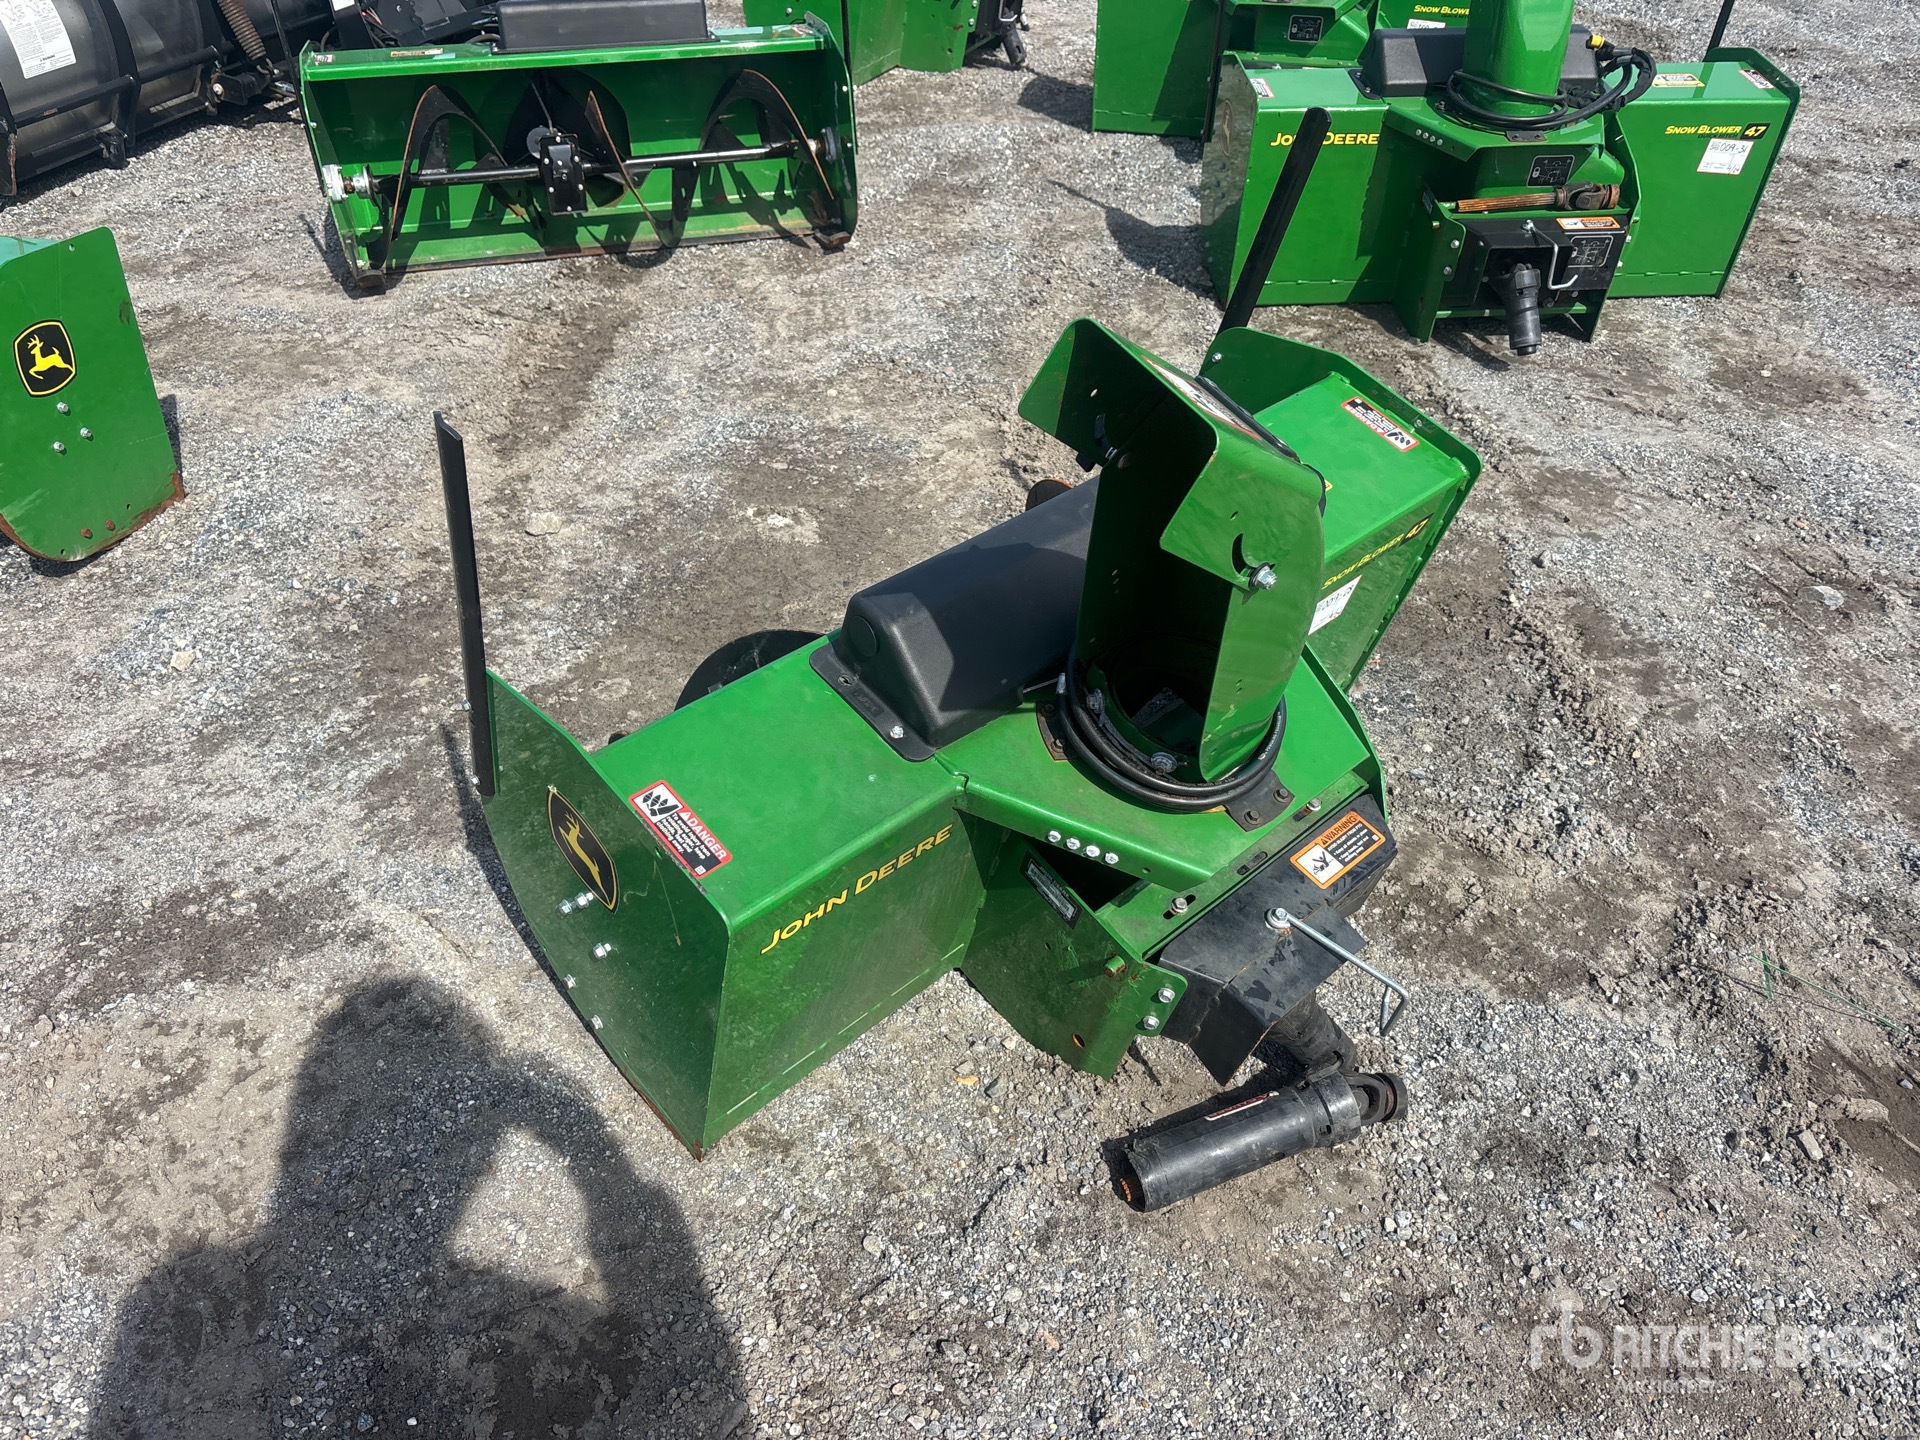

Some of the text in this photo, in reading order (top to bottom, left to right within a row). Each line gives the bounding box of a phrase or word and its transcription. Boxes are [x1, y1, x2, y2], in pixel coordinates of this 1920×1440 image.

[1414, 5, 1470, 15] SNOW BLOWE
[1270, 131, 1380, 147] JO DEERE
[1664, 124, 1767, 138] SNOW BLOWER 47
[656, 821, 674, 841] clothing
[1324, 815, 1358, 840] WARNING
[677, 819, 691, 833] avoid
[687, 831, 701, 846] injury
[699, 844, 711, 857] from
[682, 842, 693, 853] and
[686, 817, 727, 861] DANGER
[759, 887, 849, 955] JOHN
[853, 823, 953, 896] DEERE
